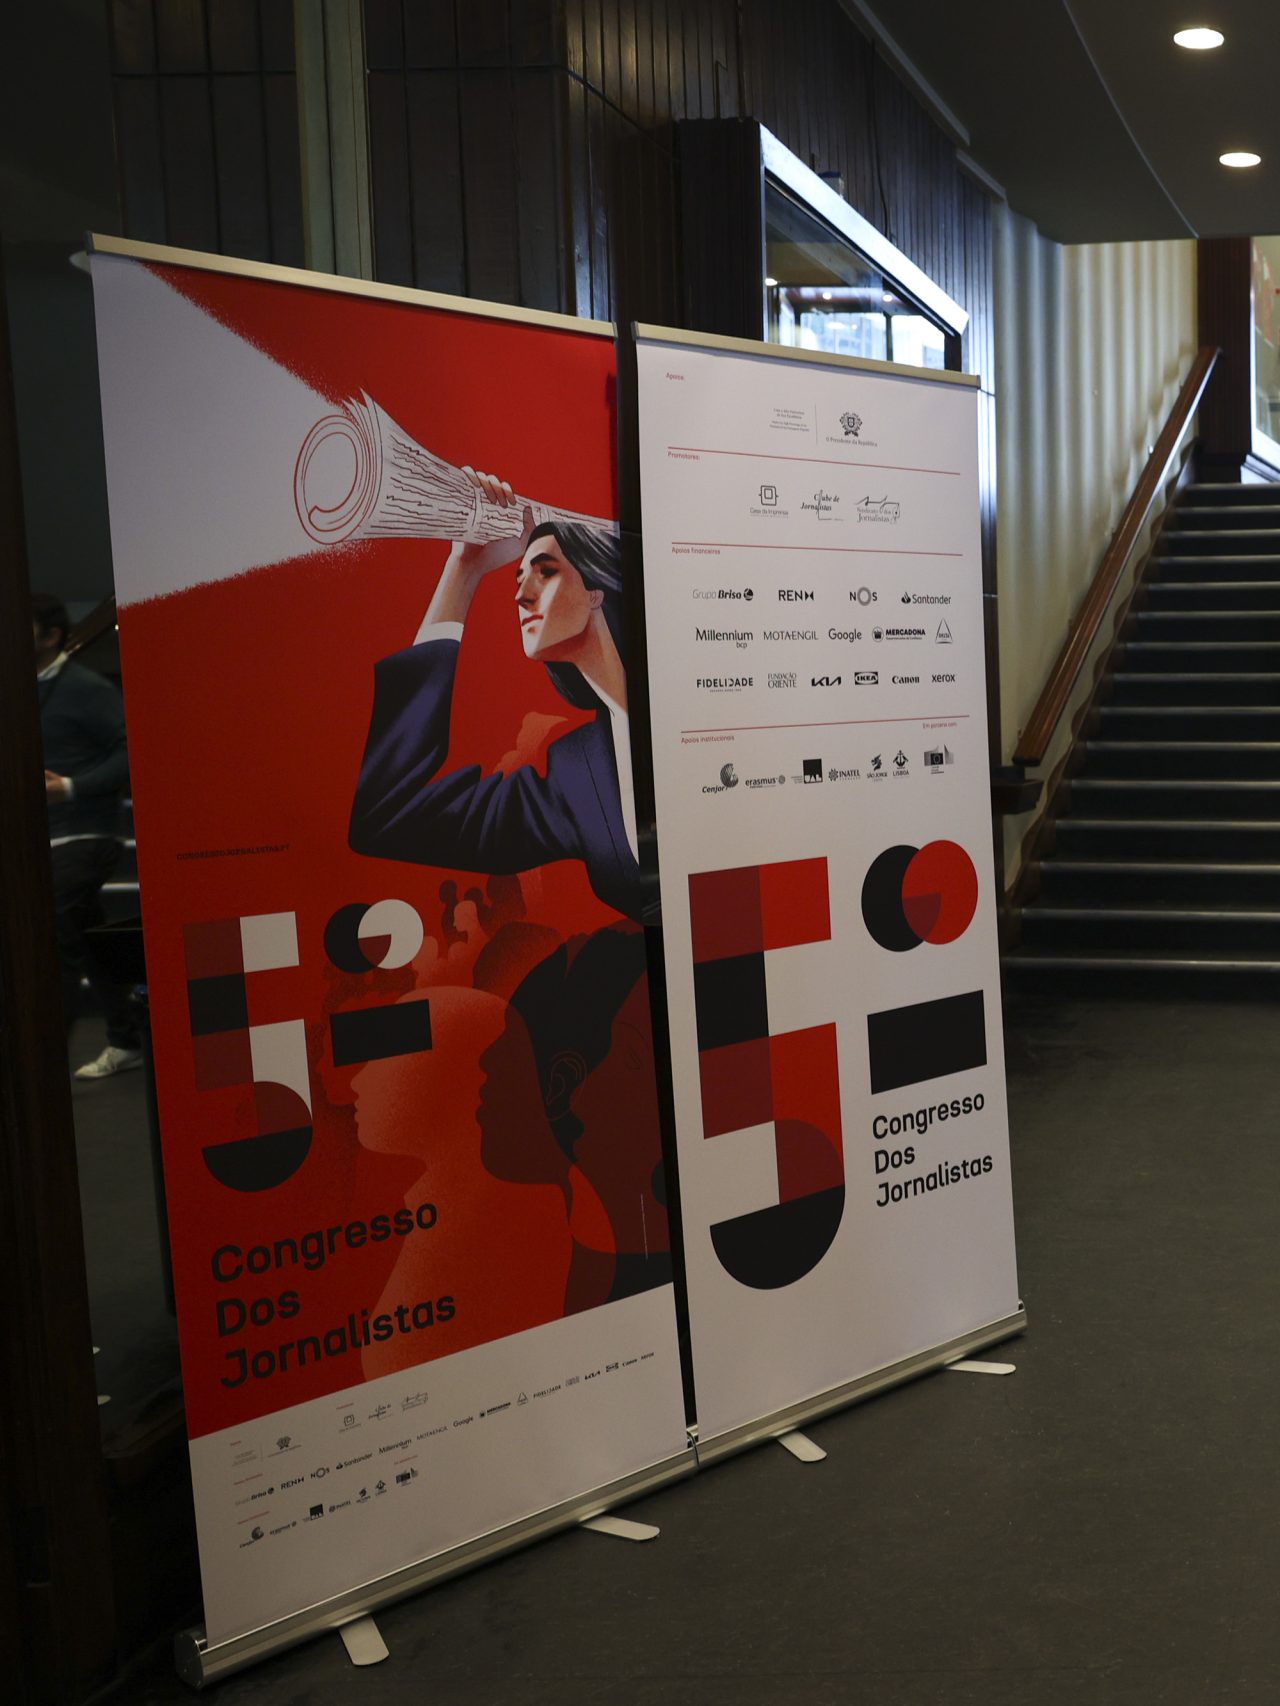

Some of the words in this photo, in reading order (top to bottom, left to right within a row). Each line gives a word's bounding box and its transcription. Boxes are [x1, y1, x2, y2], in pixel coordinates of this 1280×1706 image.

[718, 589, 742, 600] Brisa
[849, 586, 878, 607] NOS
[912, 593, 952, 605] Santander
[695, 626, 754, 641] Millennium
[828, 627, 862, 643] Google
[885, 628, 926, 636] MERCADONA
[767, 680, 797, 689] ORIENTE
[891, 675, 920, 685] Canon
[931, 673, 956, 684] xerox
[872, 1093, 985, 1140] Congresso
[874, 1145, 916, 1174] Dos
[876, 1152, 994, 1208] Jornalistas
[211, 1202, 439, 1284] Congresso
[215, 1290, 301, 1337] Dos
[220, 1295, 457, 1389] Jornalistas
[453, 1415, 474, 1428] Google
